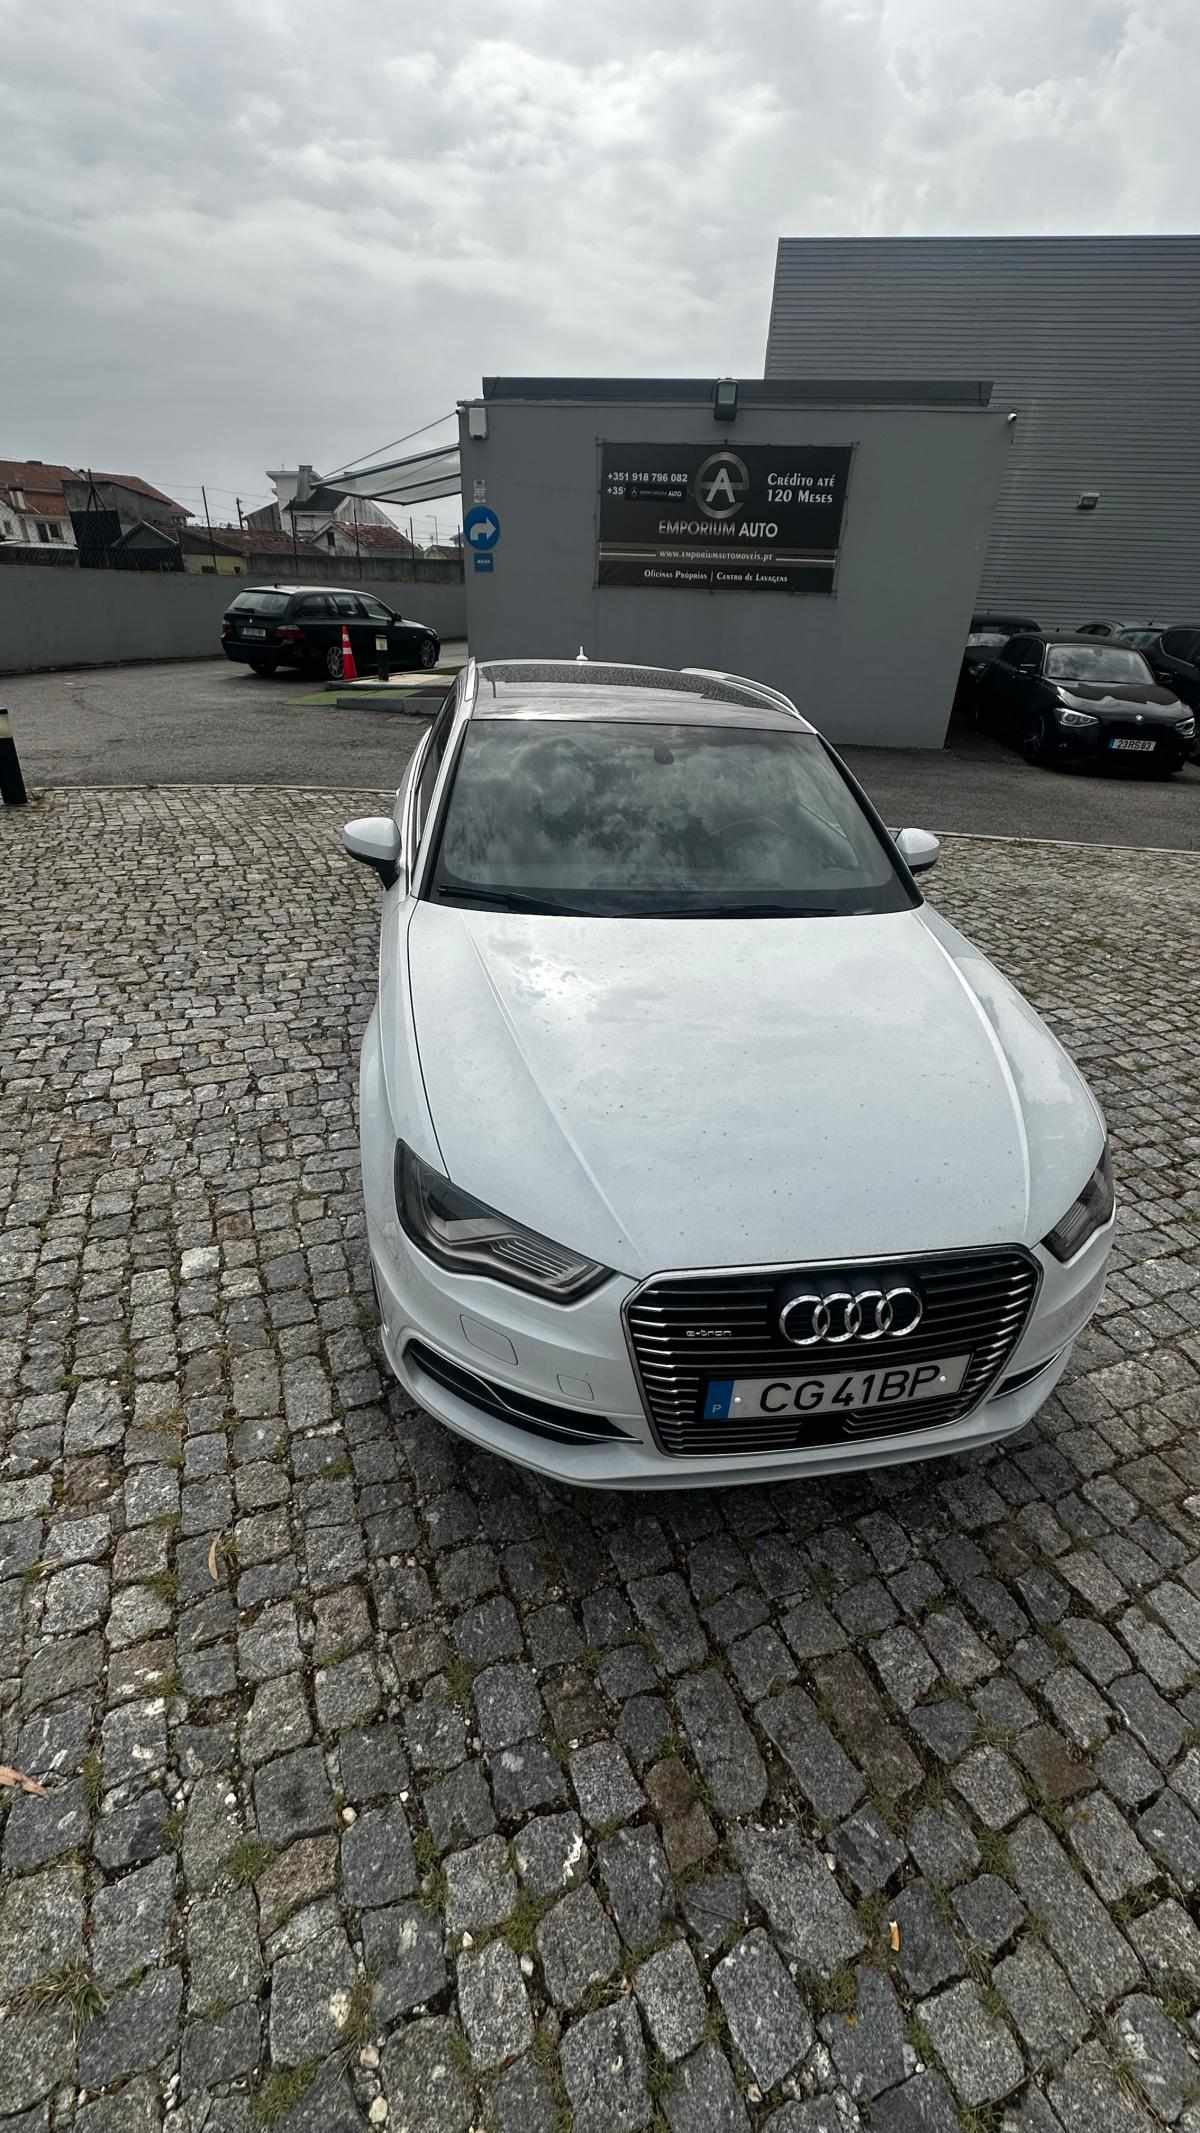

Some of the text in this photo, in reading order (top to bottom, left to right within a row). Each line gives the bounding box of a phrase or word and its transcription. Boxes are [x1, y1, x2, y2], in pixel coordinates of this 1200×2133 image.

[607, 472, 688, 482] +351 918 796 082
[767, 488, 793, 503] 120
[658, 520, 779, 538] EMPORIUM AUTO
[712, 1403, 721, 1414] P
